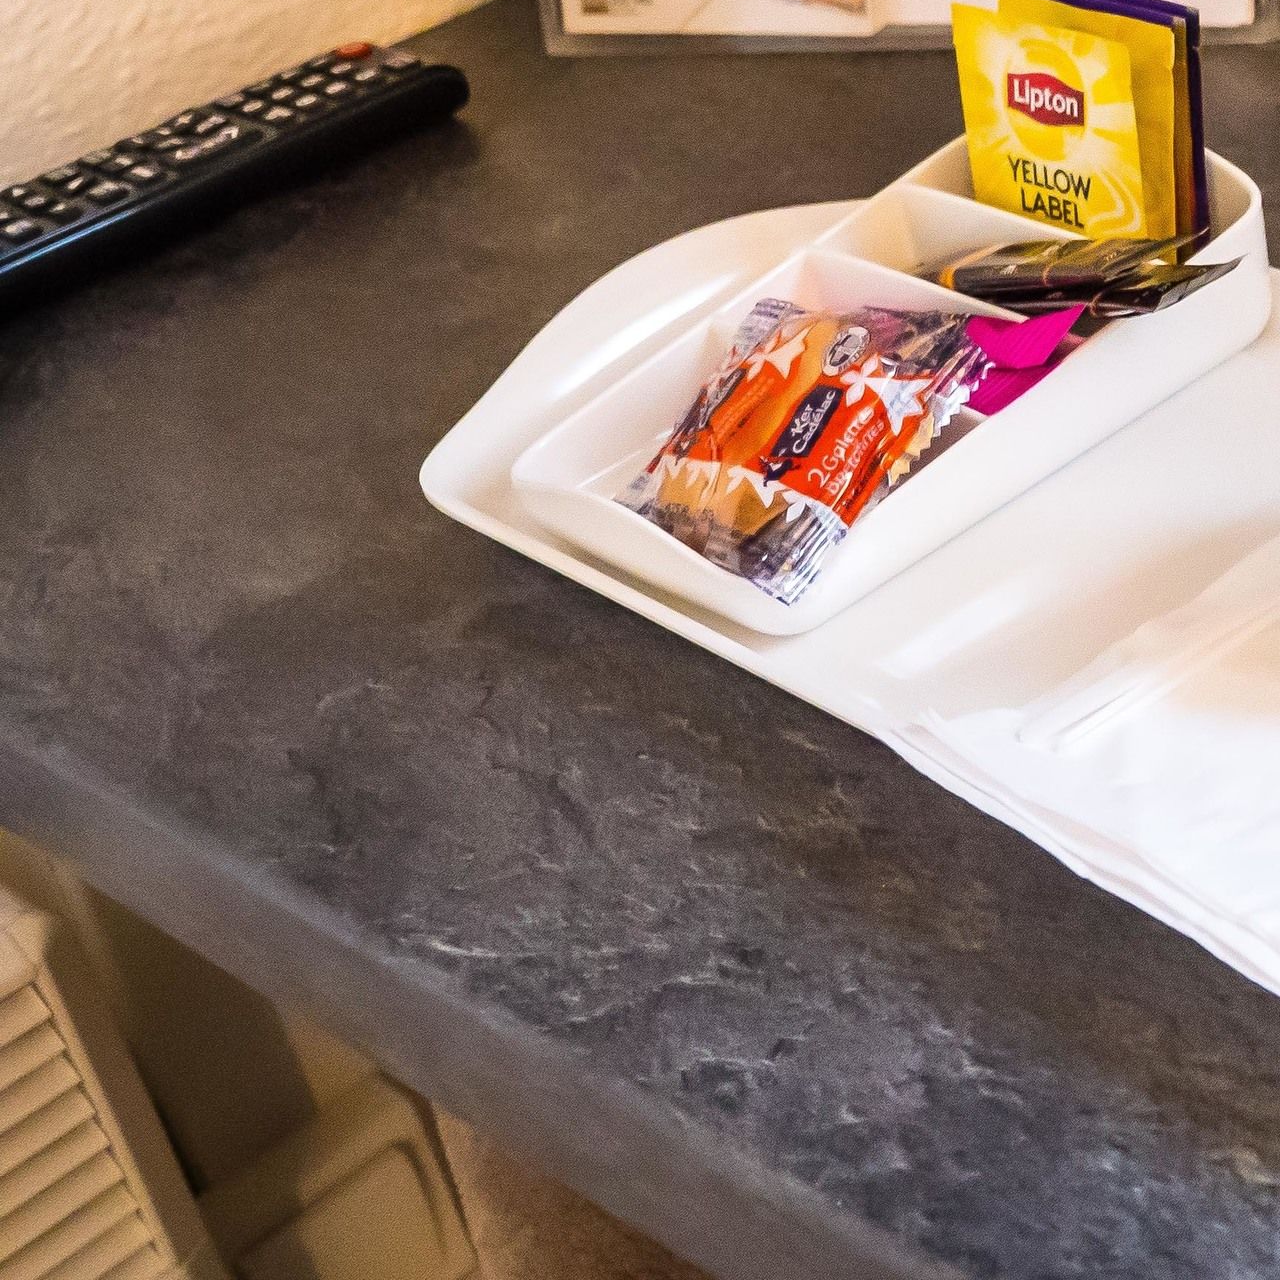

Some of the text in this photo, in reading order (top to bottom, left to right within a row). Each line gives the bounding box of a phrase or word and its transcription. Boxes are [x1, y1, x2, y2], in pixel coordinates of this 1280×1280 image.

[1013, 78, 1079, 118] Lipton
[1007, 154, 1091, 200] YELLOW
[1020, 186, 1085, 231] LABEL
[791, 402, 812, 438] Ker
[791, 390, 836, 454] Cadélac
[807, 469, 831, 488] 2
